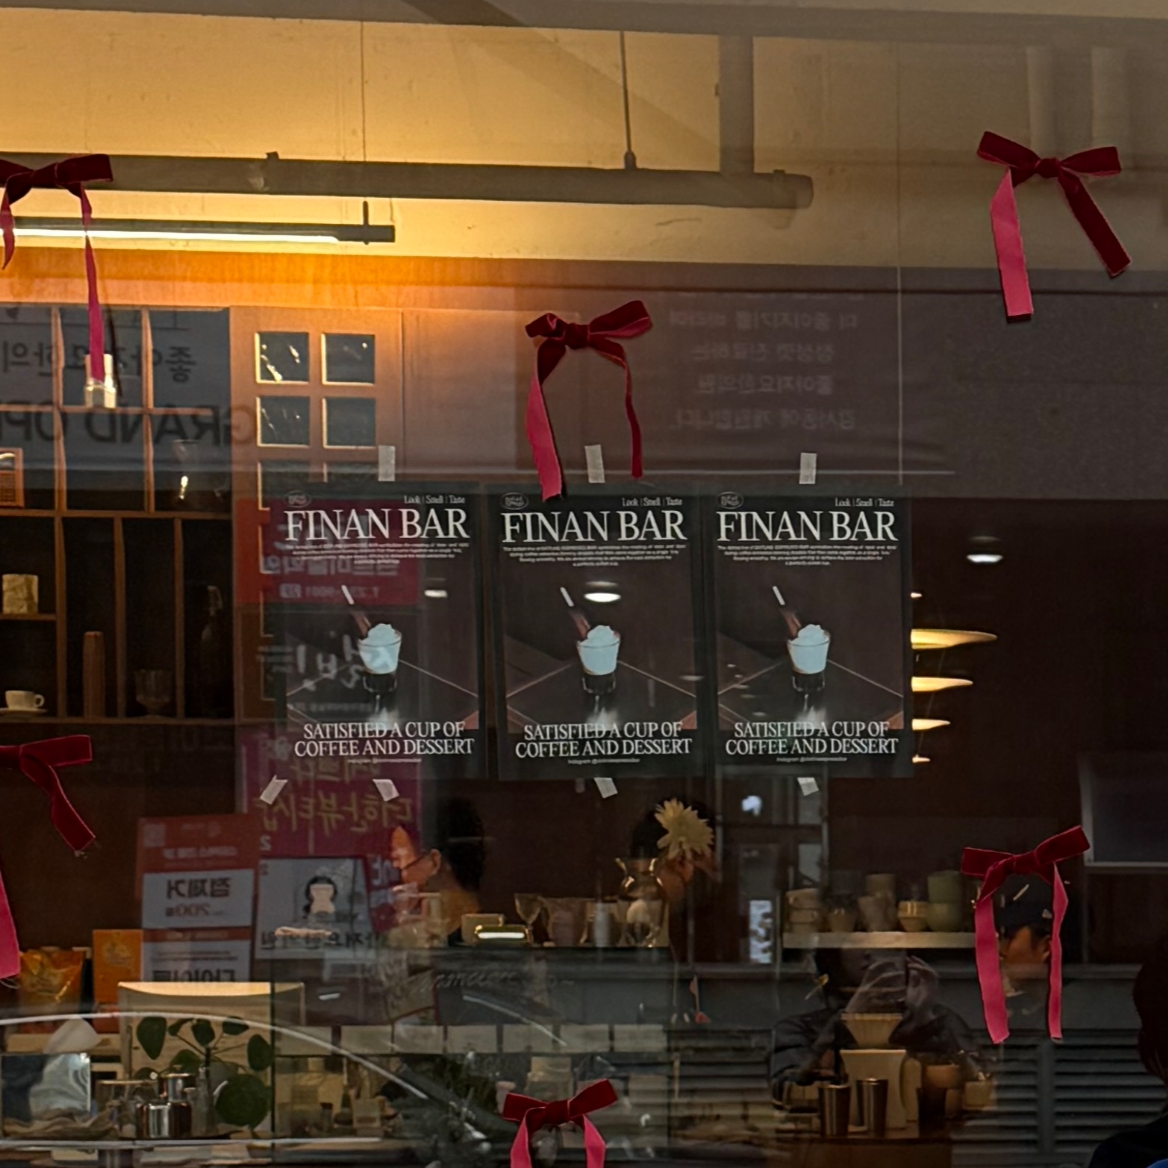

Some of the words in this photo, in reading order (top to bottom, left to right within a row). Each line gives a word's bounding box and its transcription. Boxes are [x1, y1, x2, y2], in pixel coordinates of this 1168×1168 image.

[284, 509, 391, 541] FINAN
[398, 508, 470, 539] BAR
[501, 511, 611, 542] FINAN
[616, 510, 688, 541] BAR
[716, 511, 824, 541] FINAN
[829, 511, 899, 541] BAR
[303, 722, 387, 740] SATISFIED
[390, 722, 403, 738] A
[405, 721, 441, 738] CUP
[443, 721, 466, 737] OF
[524, 723, 607, 740] SATISFIED
[609, 722, 622, 738] A
[624, 721, 658, 738] CUP
[661, 721, 683, 737] OF
[734, 721, 815, 738] SATISFIED
[817, 722, 830, 737] A
[832, 721, 866, 737] CUP
[867, 721, 890, 737] OF
[294, 740, 360, 757] COFFEE
[362, 739, 400, 756] AND
[403, 738, 475, 755] DESSERT
[515, 741, 580, 758] COFFEE
[582, 740, 619, 756] AND
[622, 738, 692, 755] DESSERT
[725, 739, 788, 755] COFFEE
[791, 738, 828, 754] AND
[830, 738, 899, 754] DESSERT
